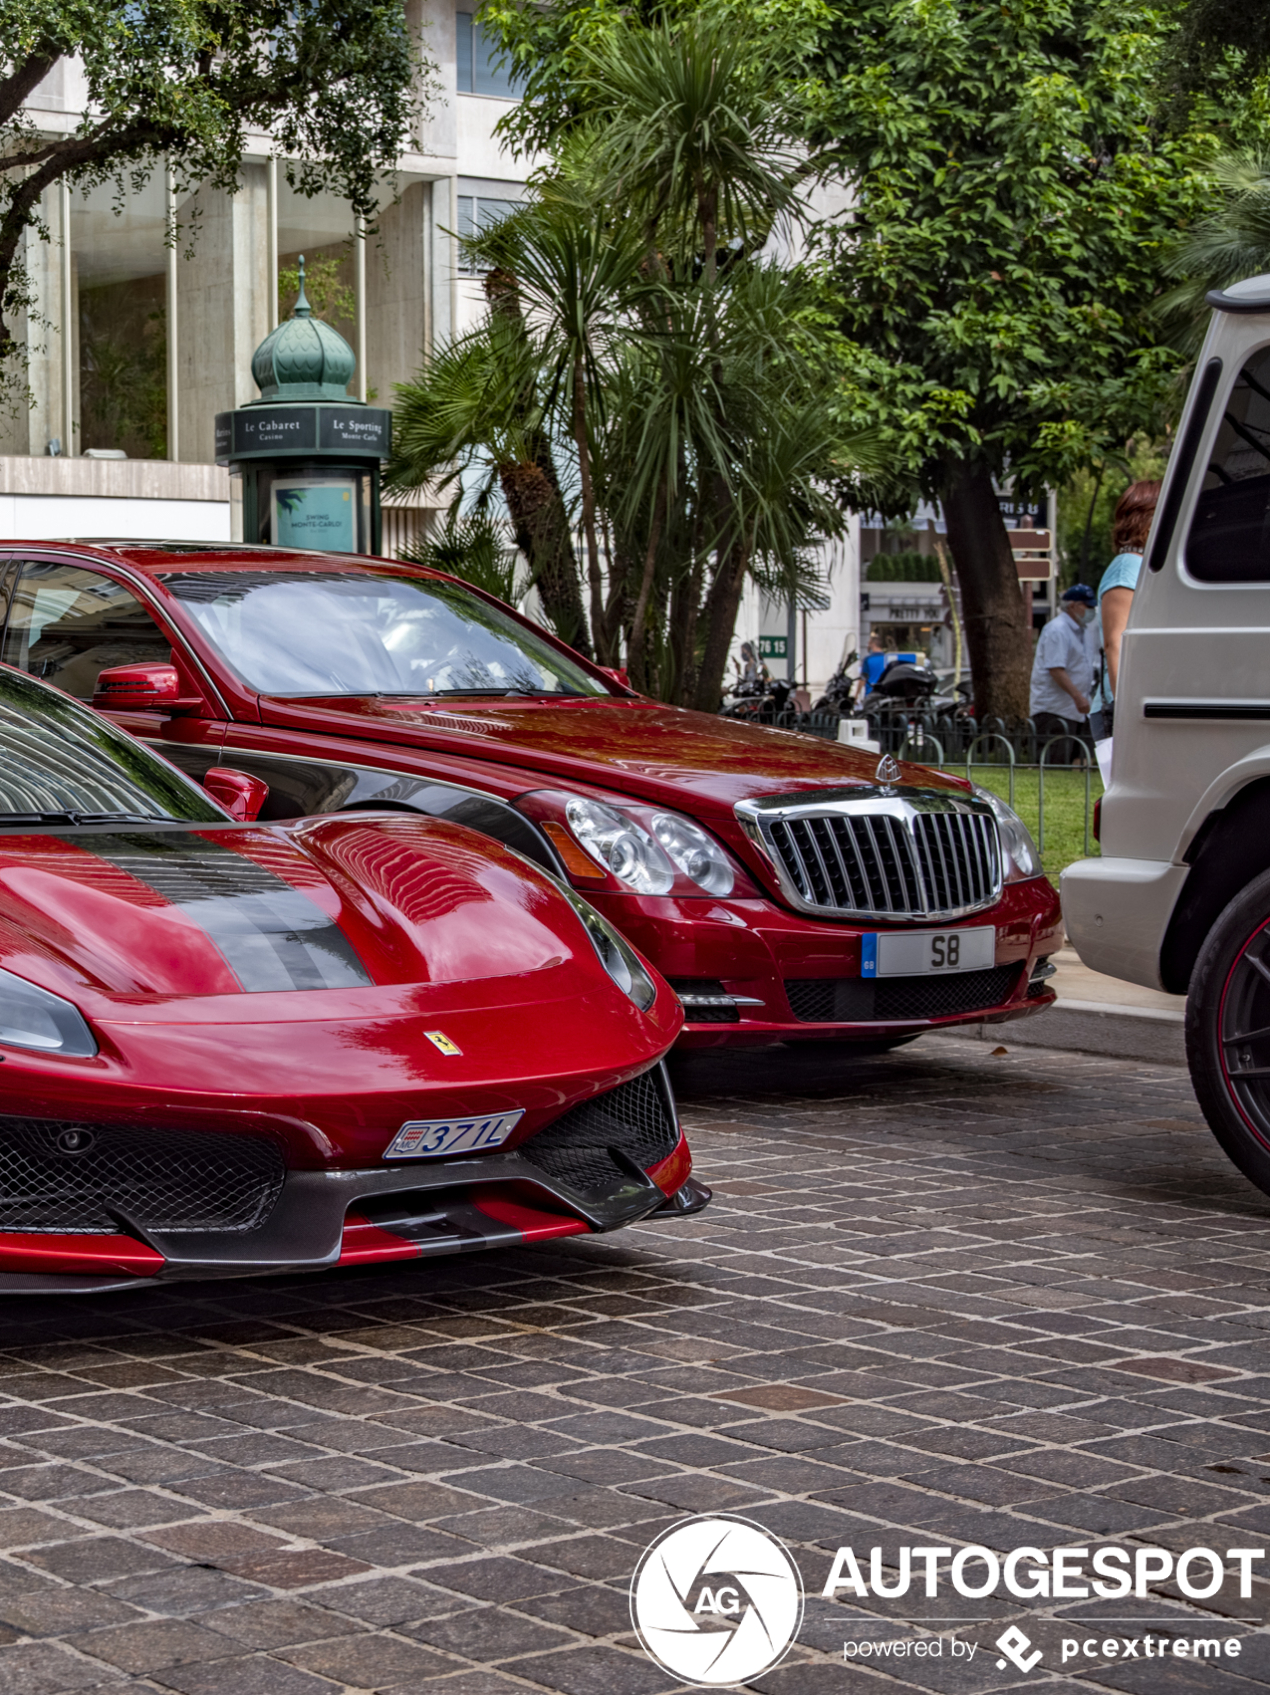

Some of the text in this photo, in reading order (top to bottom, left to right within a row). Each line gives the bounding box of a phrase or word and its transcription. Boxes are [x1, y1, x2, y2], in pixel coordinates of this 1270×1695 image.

[245, 420, 300, 432] Le Cabaret
[333, 420, 382, 435] Le Sporting
[259, 433, 283, 441] Casino
[889, 608, 940, 619] PRETTY YOU
[760, 640, 786, 654] 76 15
[931, 934, 960, 967] S8
[863, 960, 875, 970] GB
[422, 1118, 505, 1153] 371L
[399, 1140, 416, 1150] MC
